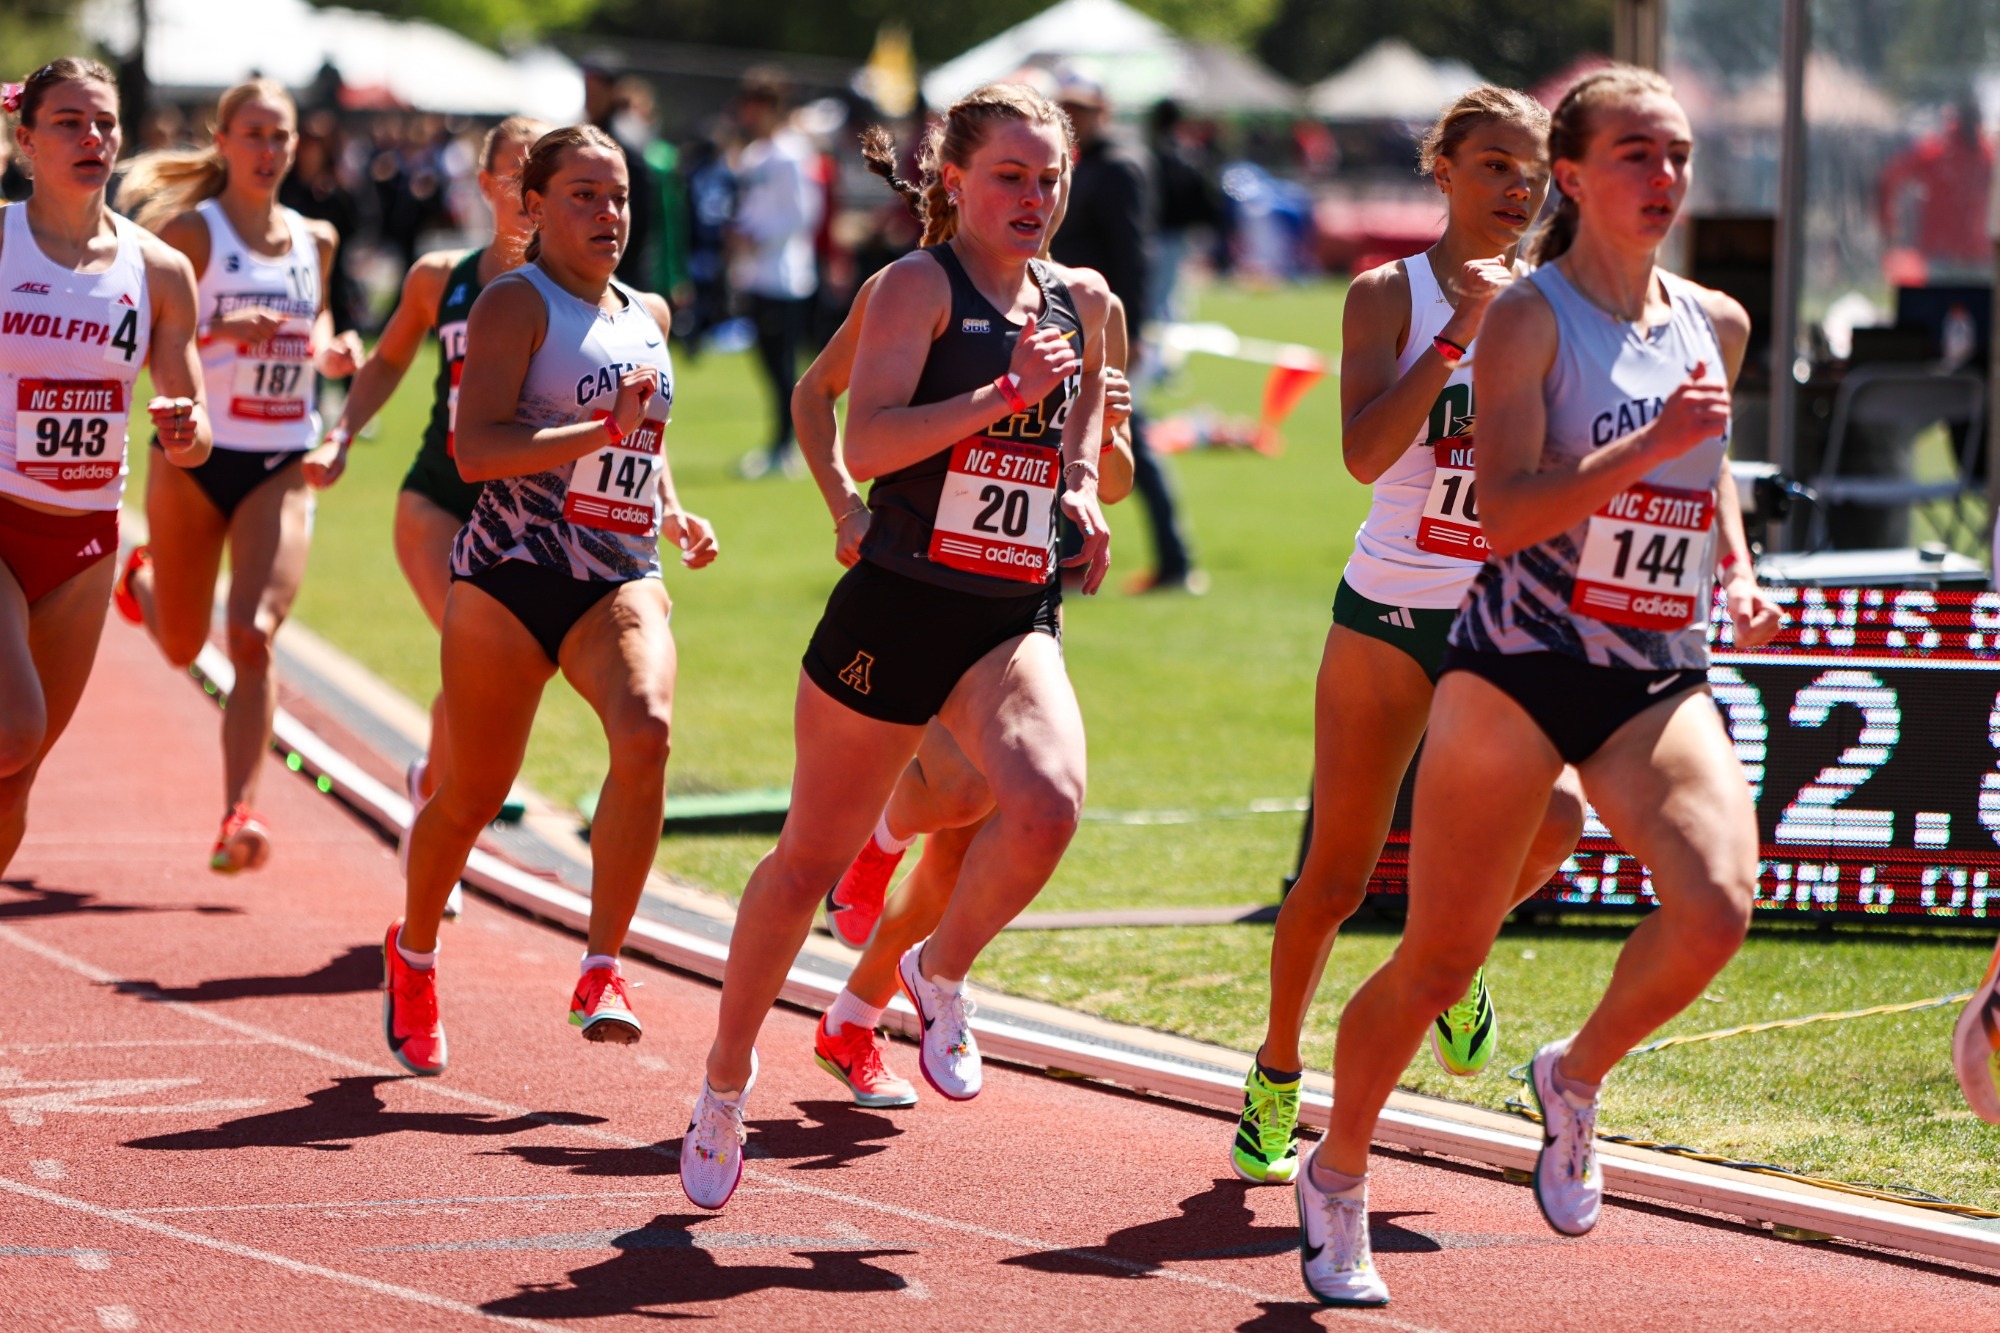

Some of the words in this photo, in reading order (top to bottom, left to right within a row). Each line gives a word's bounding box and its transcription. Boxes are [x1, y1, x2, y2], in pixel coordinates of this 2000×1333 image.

[14, 282, 51, 294] ACC
[111, 308, 138, 362] 4
[962, 318, 990, 333] SBC
[255, 363, 303, 397] 187
[577, 362, 673, 406] CATB
[30, 389, 58, 410] NC
[61, 389, 113, 411] STATE
[36, 417, 108, 457] 943
[61, 464, 114, 480] adidas
[597, 452, 652, 499] 147
[963, 448, 996, 474] NC
[997, 454, 1051, 484] STATE
[611, 506, 649, 525] adidas
[972, 484, 1029, 538] 20
[1606, 492, 1643, 519] NC
[1643, 496, 1704, 528] STATE
[985, 546, 1043, 569] adidas
[1613, 528, 1690, 588] 144
[1631, 595, 1688, 619] adidas
[838, 650, 874, 695] A
